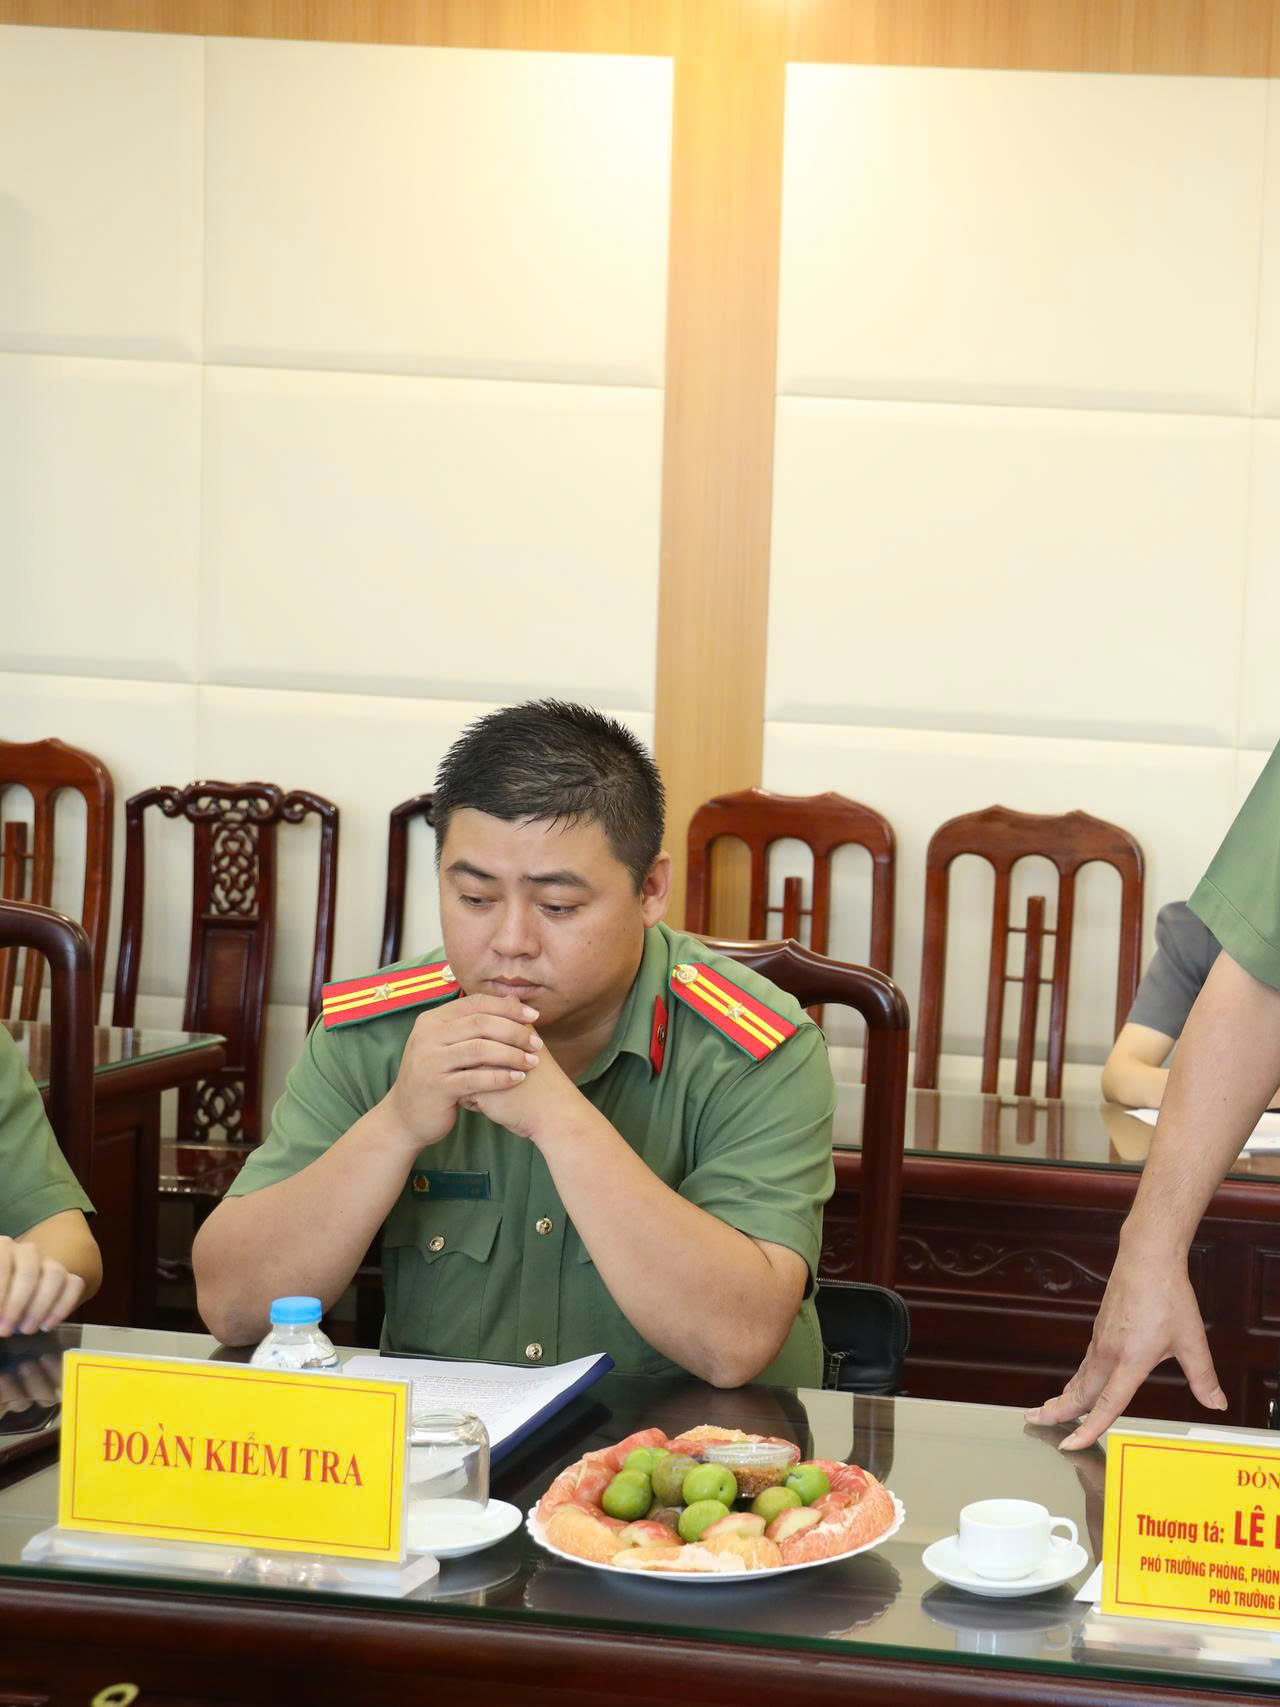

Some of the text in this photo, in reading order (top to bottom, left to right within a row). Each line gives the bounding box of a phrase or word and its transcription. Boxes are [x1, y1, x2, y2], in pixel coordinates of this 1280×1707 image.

[103, 1423, 364, 1486] ĐOÀN KIỂM TRA
[1136, 1513, 1198, 1544] Thượng
[1203, 1520, 1225, 1544] tá:
[1234, 1504, 1265, 1548] LÊ
[1140, 1554, 1161, 1573] PHÓ
[1165, 1555, 1206, 1577] TRƯỞNG
[1209, 1561, 1248, 1584] PHÒNG,
[1209, 1587, 1230, 1606] PHÓ
[1233, 1588, 1275, 1610] TRƯỞNG
